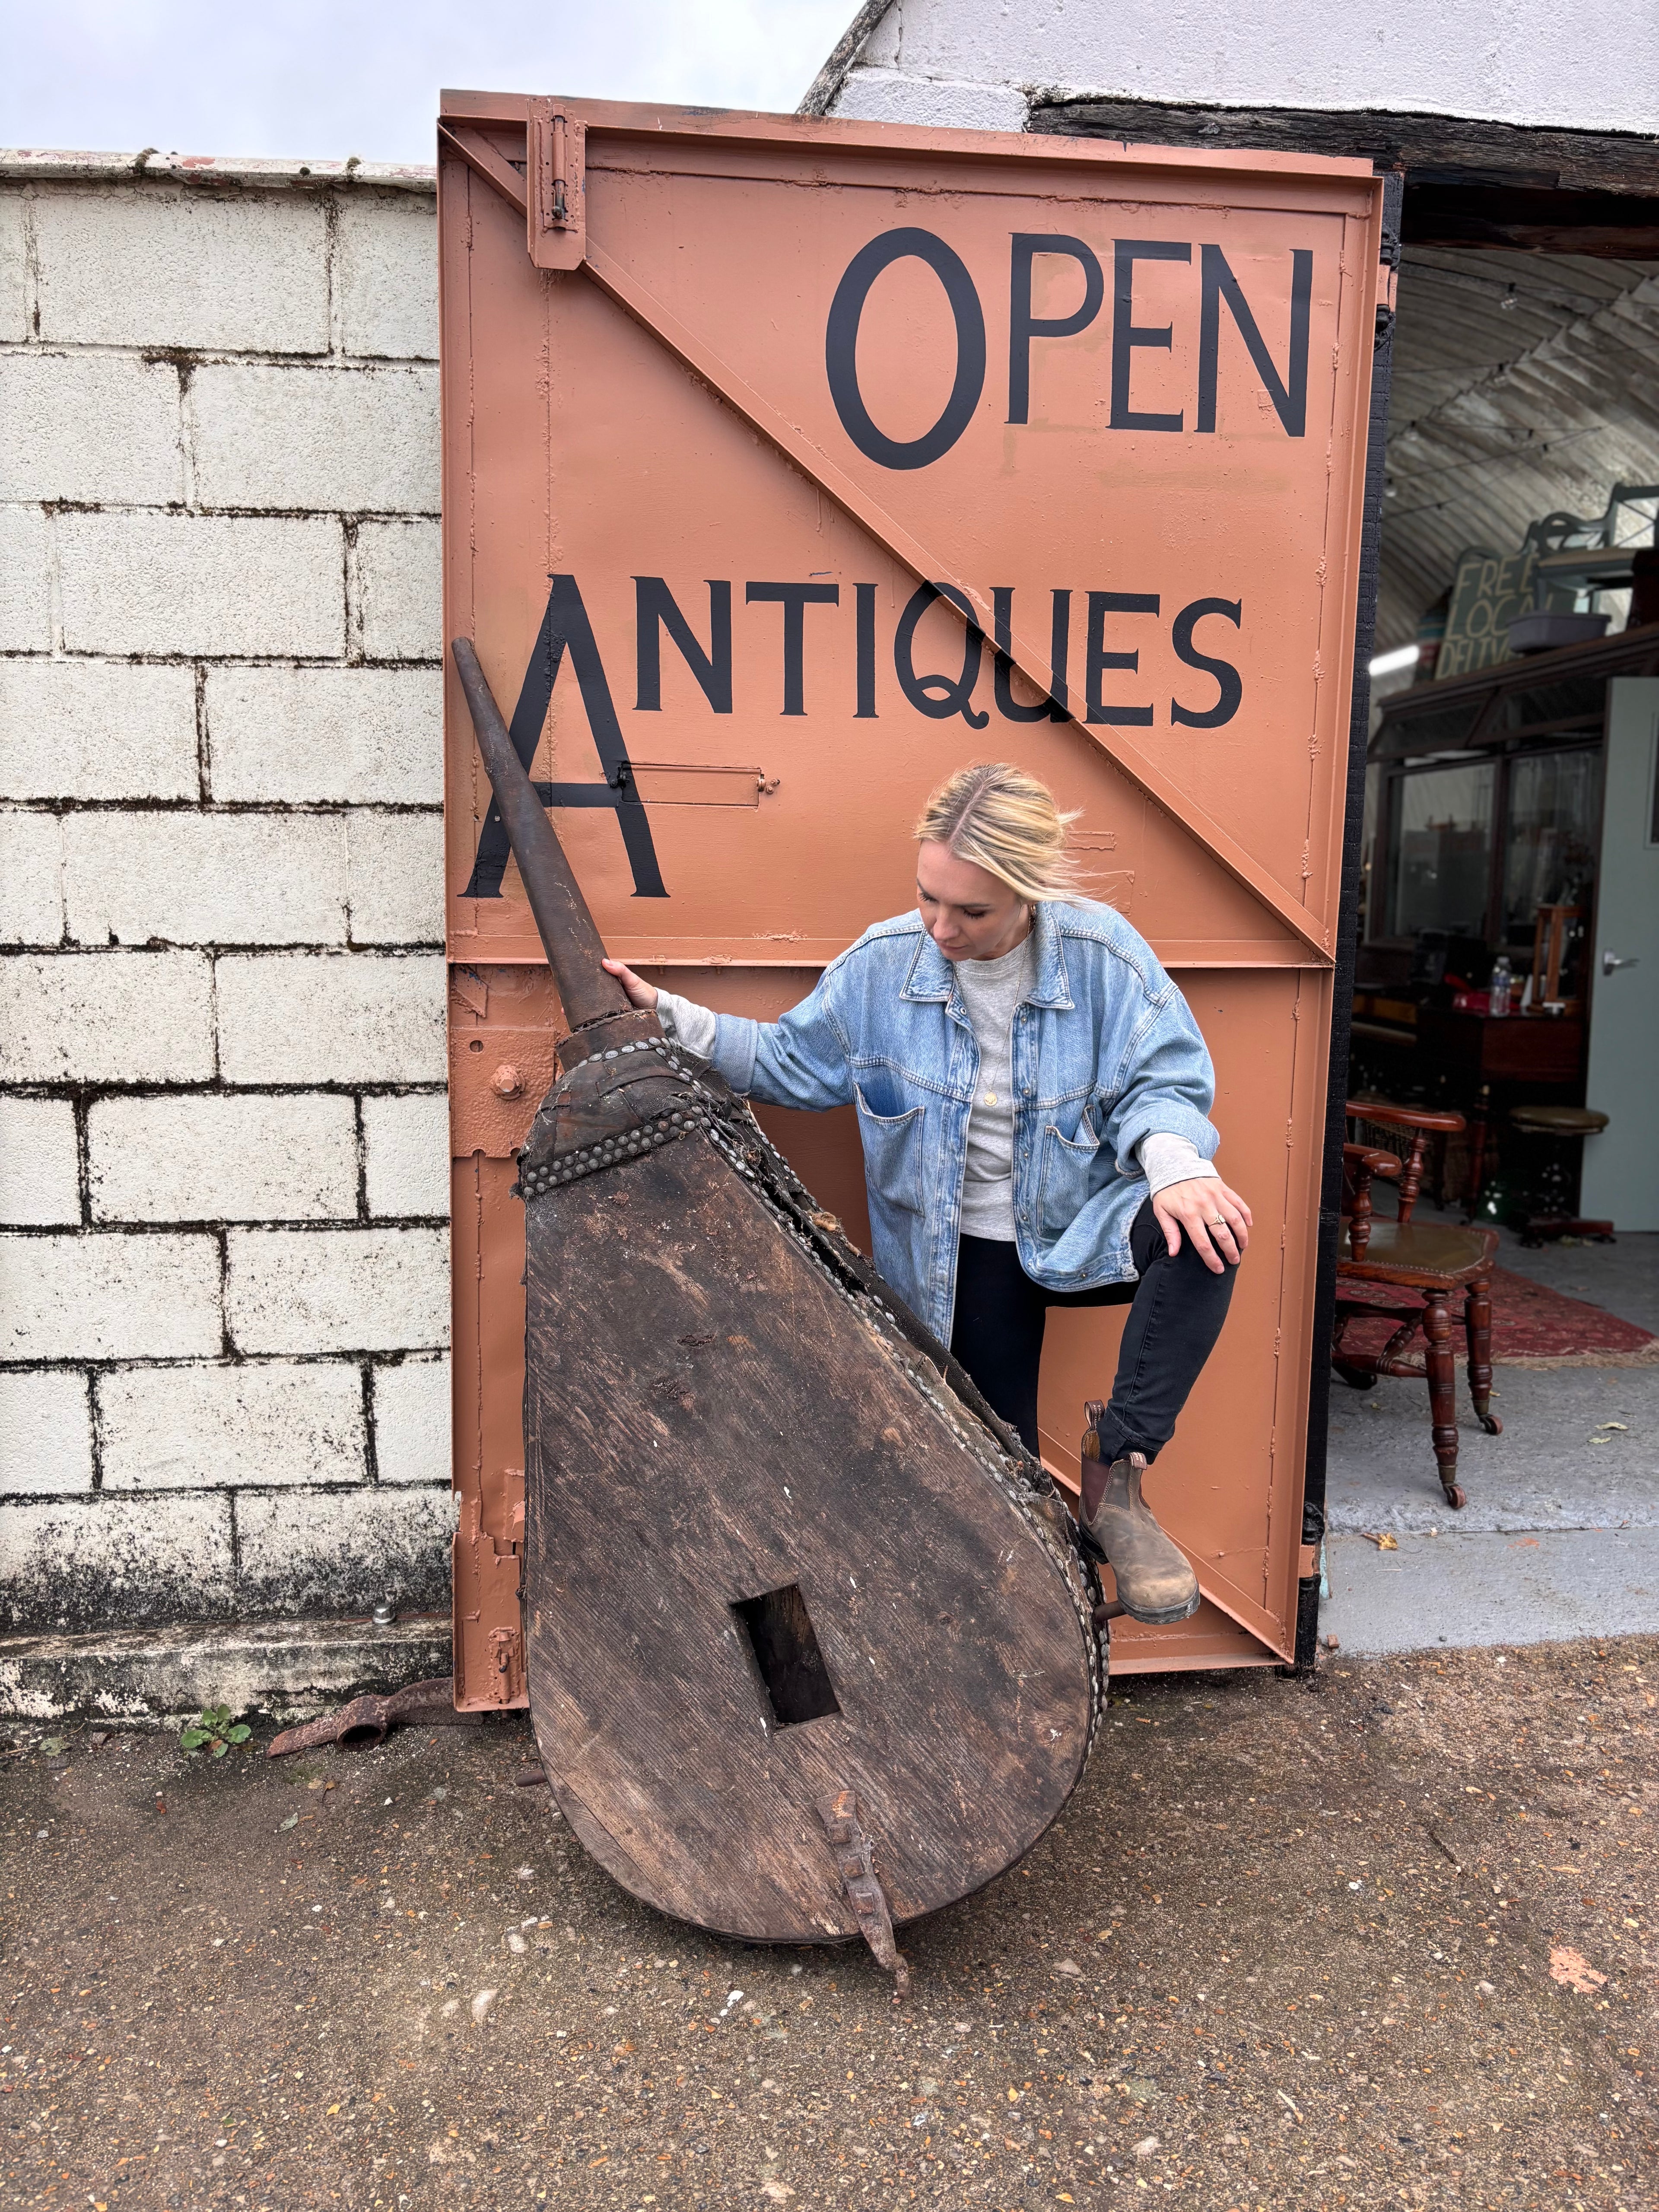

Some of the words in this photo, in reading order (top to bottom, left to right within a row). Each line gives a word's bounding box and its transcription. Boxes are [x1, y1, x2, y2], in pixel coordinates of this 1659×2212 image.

[826, 227, 1313, 470] OPEN
[1455, 553, 1539, 600] FREE
[457, 573, 1242, 898] ANTIQUES
